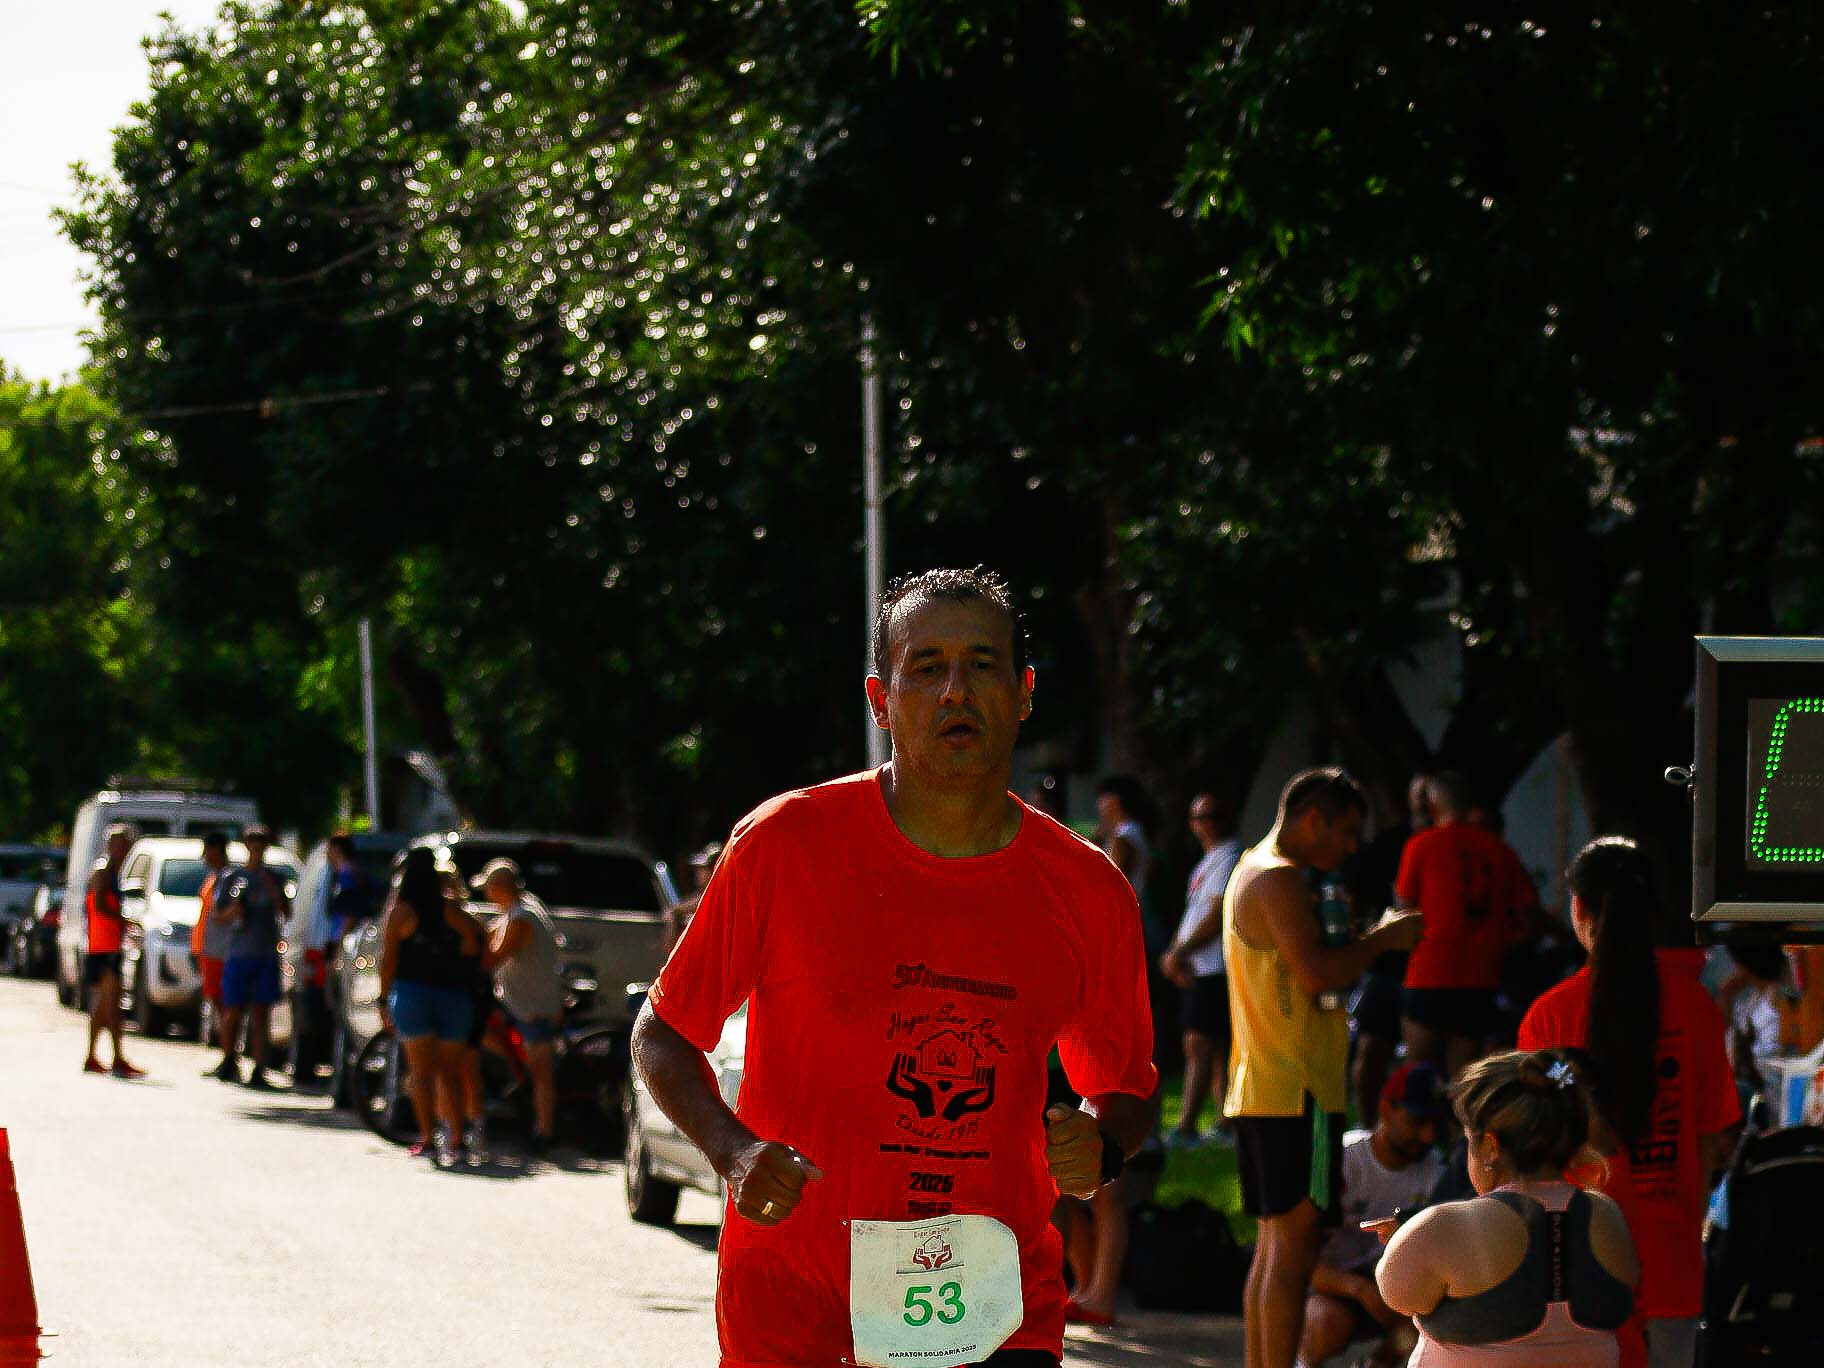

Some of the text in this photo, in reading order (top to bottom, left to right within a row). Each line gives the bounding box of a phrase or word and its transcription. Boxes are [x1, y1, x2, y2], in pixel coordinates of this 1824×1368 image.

[909, 1171, 954, 1193] 2025
[903, 1281, 967, 1327] 53
[923, 1347, 960, 1358] SOLIDARIA
[961, 1344, 977, 1353] 2025
